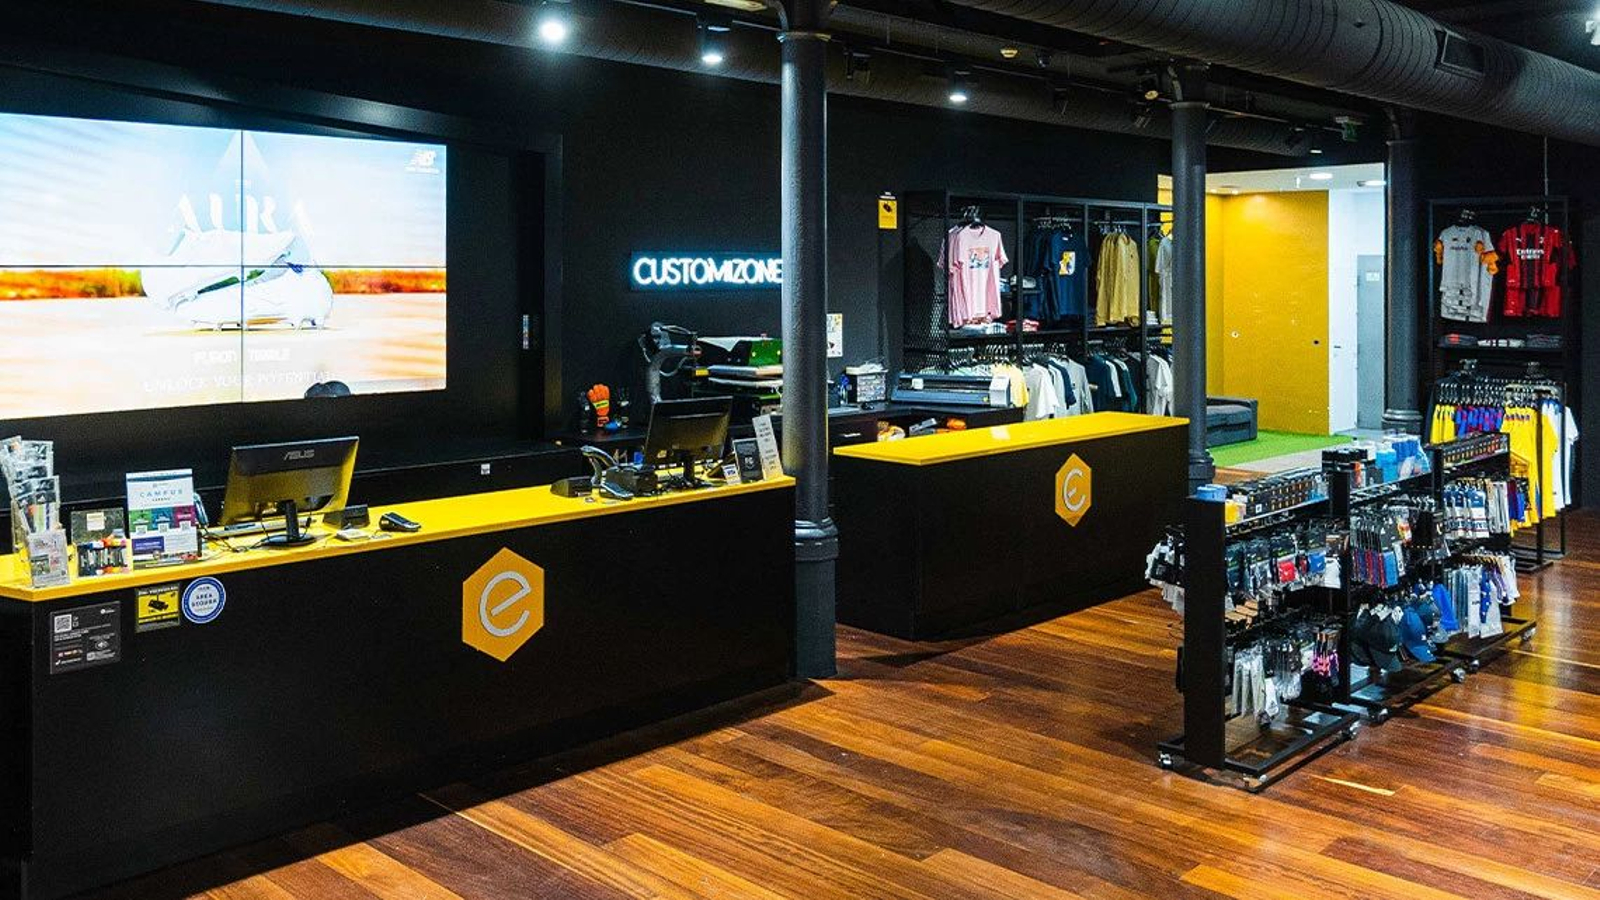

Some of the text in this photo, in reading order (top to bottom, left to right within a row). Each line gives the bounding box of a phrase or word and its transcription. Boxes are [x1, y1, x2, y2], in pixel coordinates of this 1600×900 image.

[633, 257, 783, 285] CUSTOMIZONE
[283, 449, 315, 461] ASUS
[479, 570, 532, 637] e
